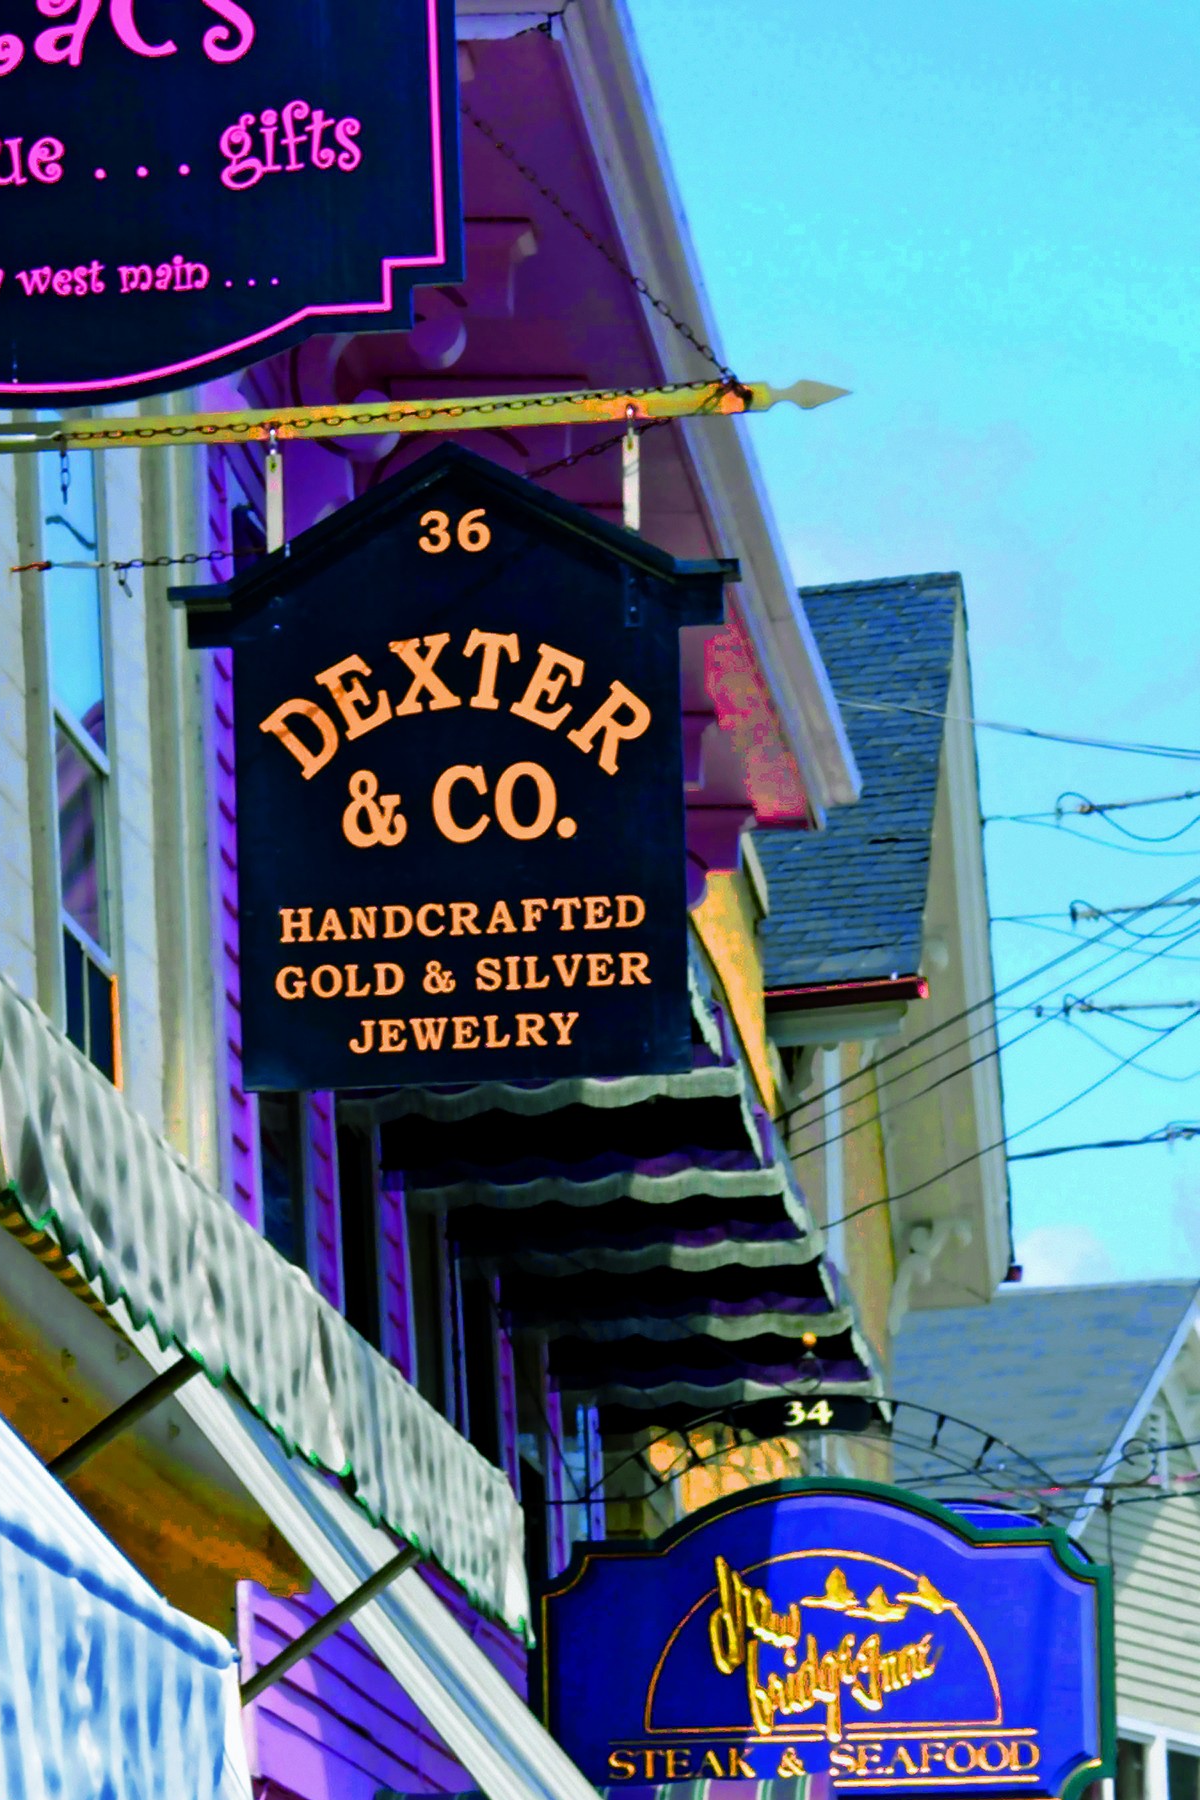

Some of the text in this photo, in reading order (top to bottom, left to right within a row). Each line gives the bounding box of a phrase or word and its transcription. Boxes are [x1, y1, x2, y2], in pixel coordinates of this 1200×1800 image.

[219, 99, 362, 191] gifts
[15, 259, 106, 297] west
[117, 254, 210, 294] main
[418, 508, 491, 554] 36
[258, 627, 652, 781] DEXTER
[342, 761, 578, 848] & CO.
[278, 894, 646, 944] HANDCRAFTED
[275, 951, 652, 1000] GOLD & SILVER
[348, 1011, 580, 1054] JEWELRY
[784, 1399, 834, 1427] 34
[607, 1740, 1040, 1780] STEAK & SEAFOOD
